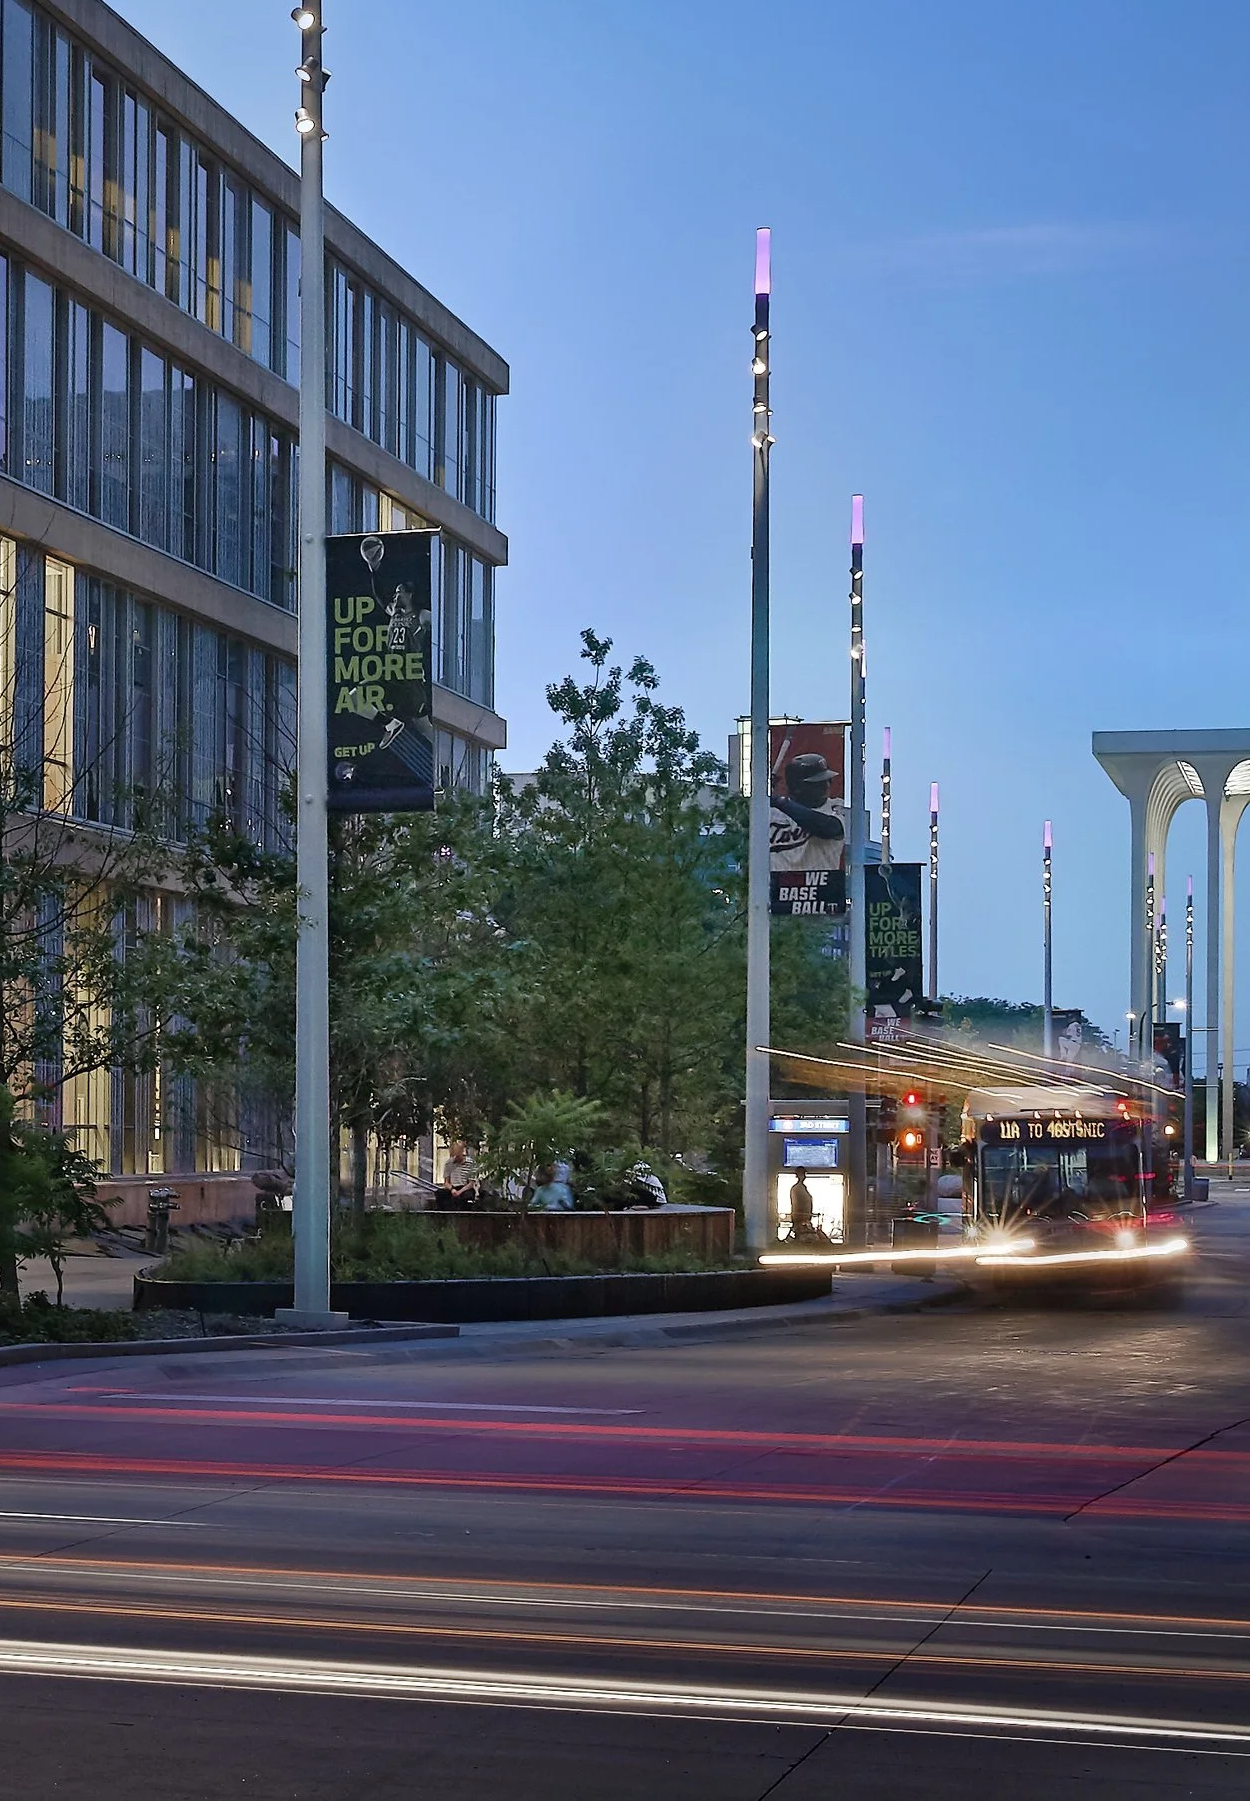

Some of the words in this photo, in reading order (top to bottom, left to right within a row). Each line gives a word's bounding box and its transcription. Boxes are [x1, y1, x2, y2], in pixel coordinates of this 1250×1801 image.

[334, 596, 375, 624] UP
[334, 625, 390, 654] FOR
[393, 627, 406, 644] 23
[334, 653, 424, 683] MORE
[334, 685, 394, 714] AIR.
[334, 746, 357, 758] GET
[358, 742, 375, 756] UP
[805, 871, 828, 886] WE
[779, 887, 817, 901] BASE
[791, 901, 827, 915] BALL
[869, 902, 892, 916] UP
[869, 917, 900, 931] FOR
[869, 931, 918, 945] MORE
[887, 1018, 901, 1027] WE
[871, 1026, 894, 1035] BASE
[1027, 1122, 1043, 1139] TO
